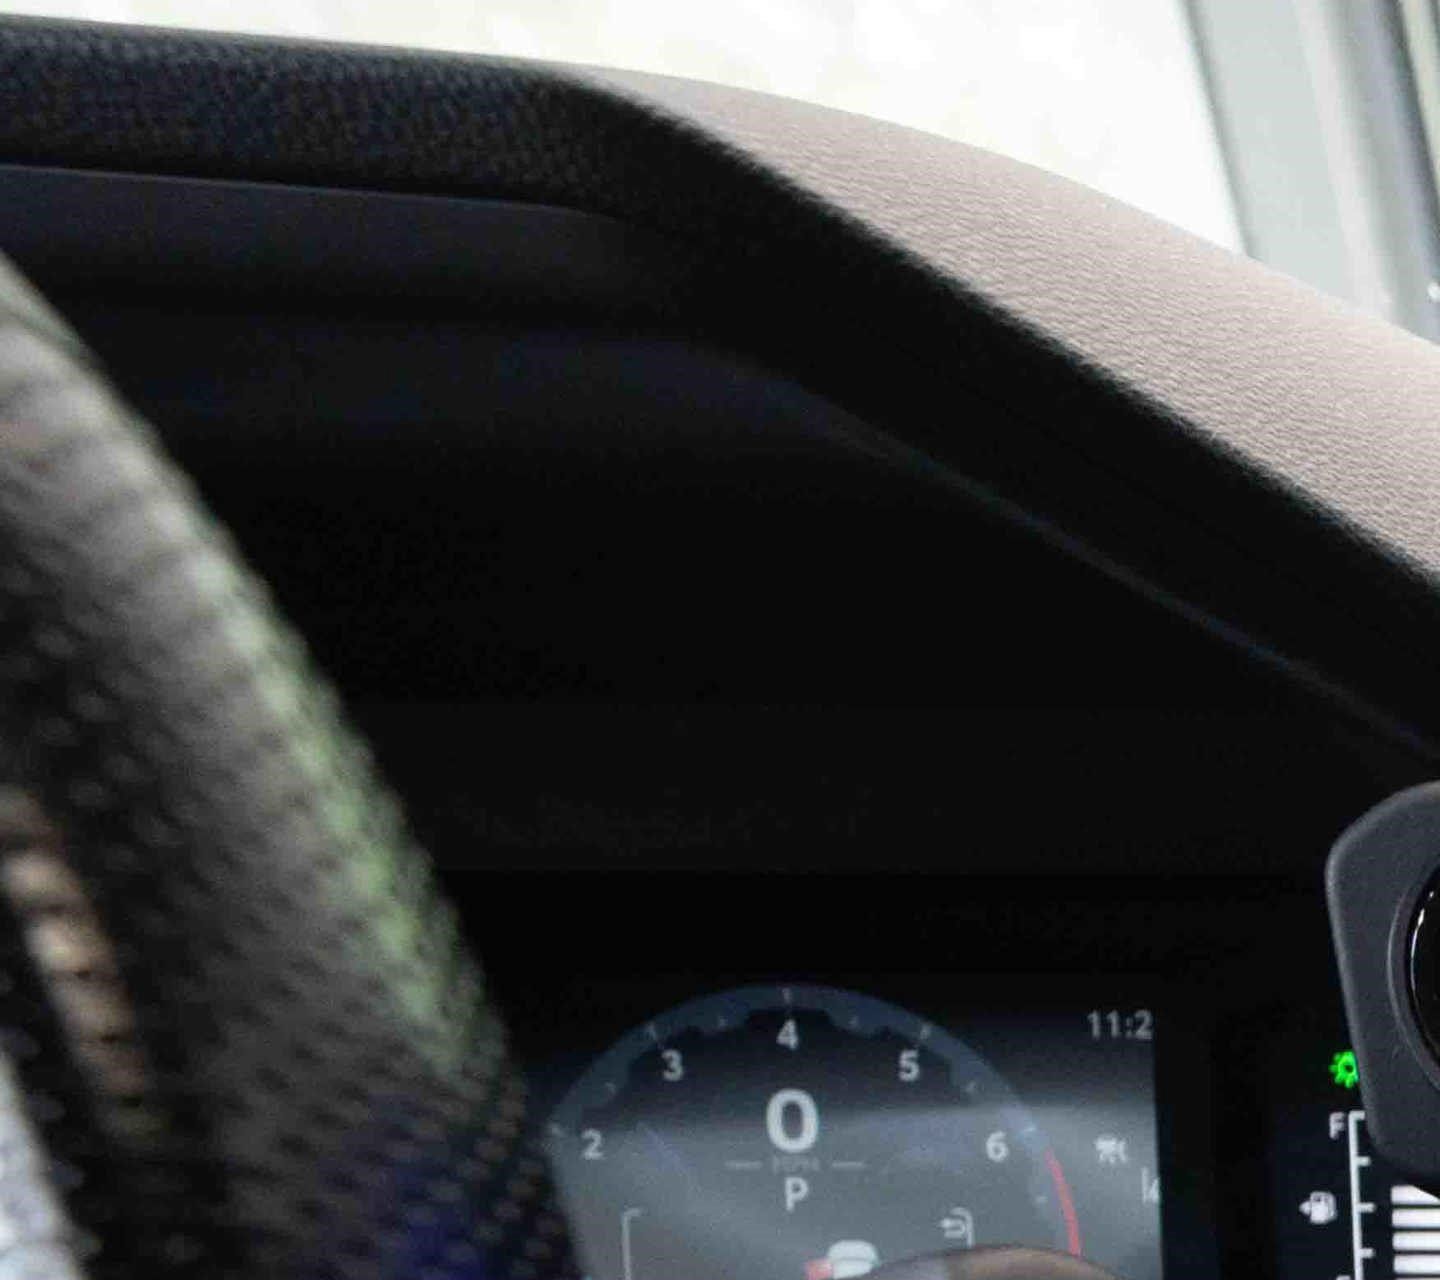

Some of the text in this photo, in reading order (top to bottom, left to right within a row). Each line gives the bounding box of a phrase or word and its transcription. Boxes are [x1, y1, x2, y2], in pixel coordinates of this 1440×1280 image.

[776, 1019, 798, 1049] 4
[661, 1049, 683, 1080] 3
[899, 1049, 919, 1080] 5
[765, 1088, 819, 1152] 0
[581, 1130, 603, 1160] 2
[986, 1131, 1007, 1162] 6
[783, 1177, 808, 1212] P
